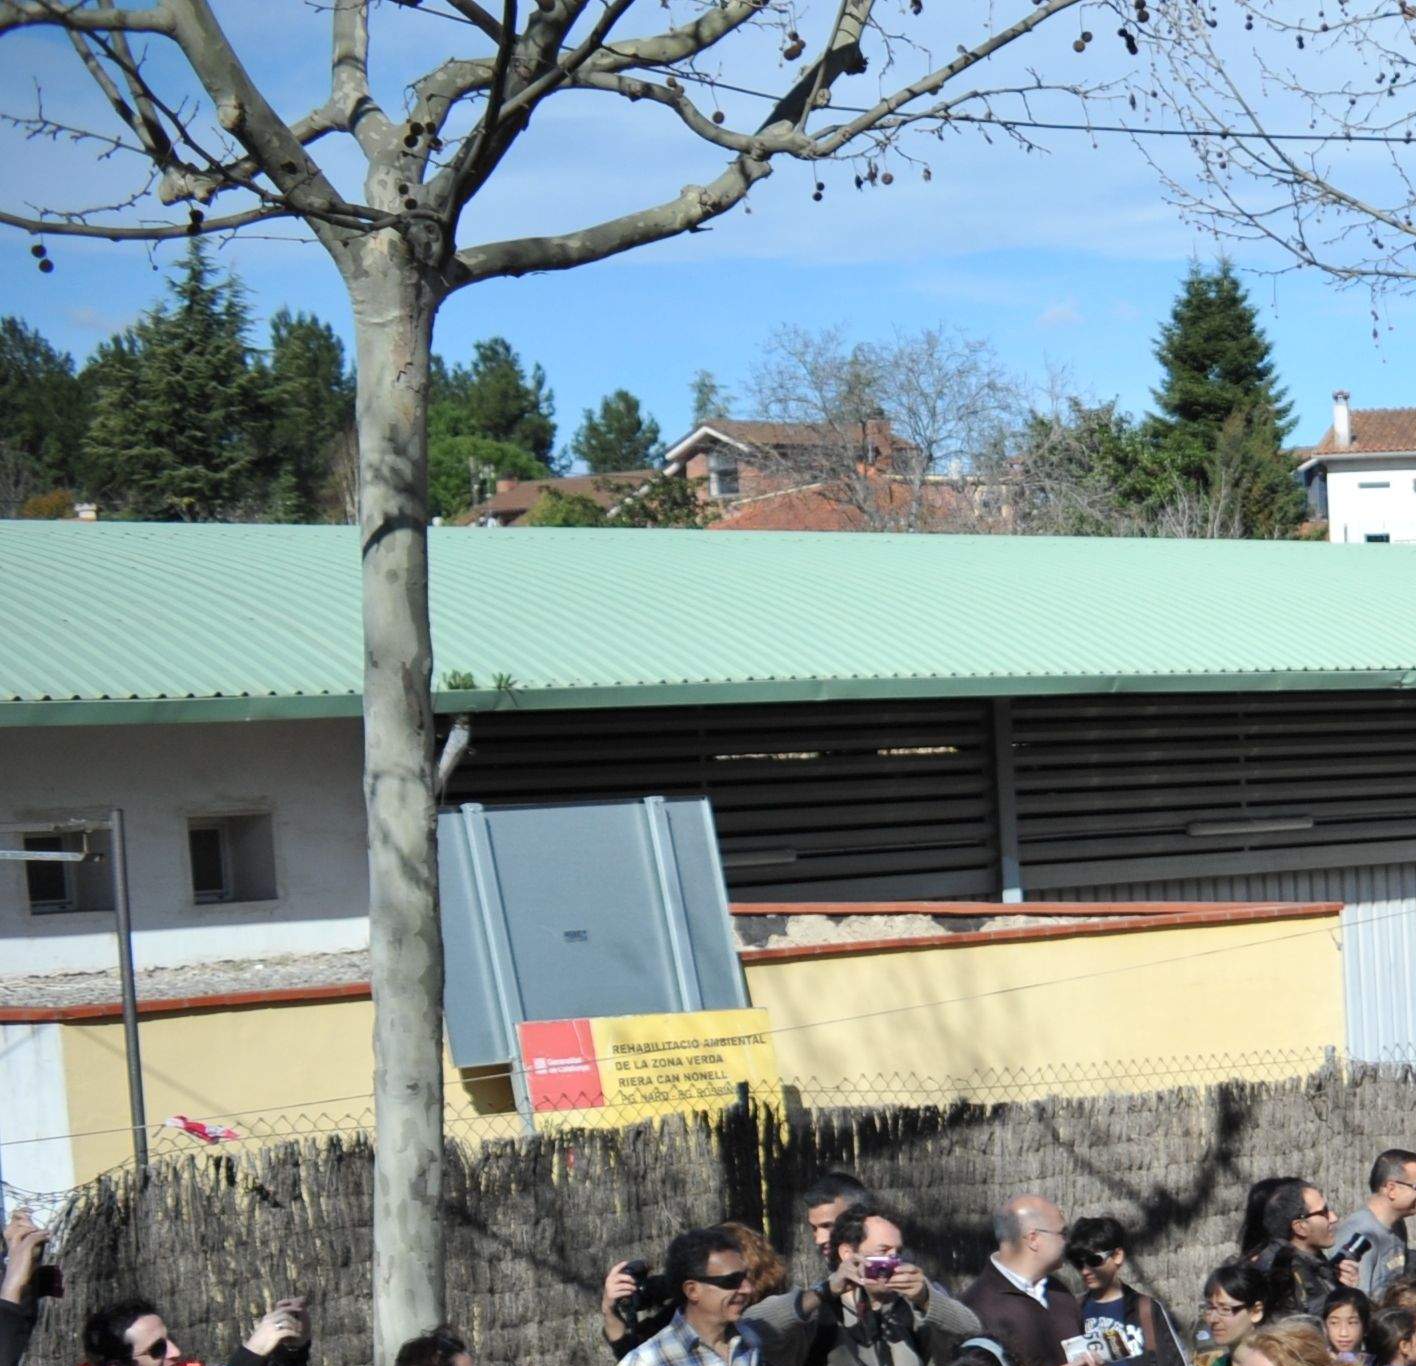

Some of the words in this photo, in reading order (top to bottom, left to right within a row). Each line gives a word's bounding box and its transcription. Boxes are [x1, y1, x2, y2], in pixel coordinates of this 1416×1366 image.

[702, 1034, 767, 1049] AMBIENTAL
[615, 1059, 630, 1071] DE
[634, 1058, 648, 1070] LA
[651, 1056, 683, 1068] ZONA
[687, 1053, 723, 1066] VERDA
[618, 1075, 653, 1088] RIERA
[656, 1074, 680, 1085] CAN
[684, 1070, 728, 1083] NONELL
